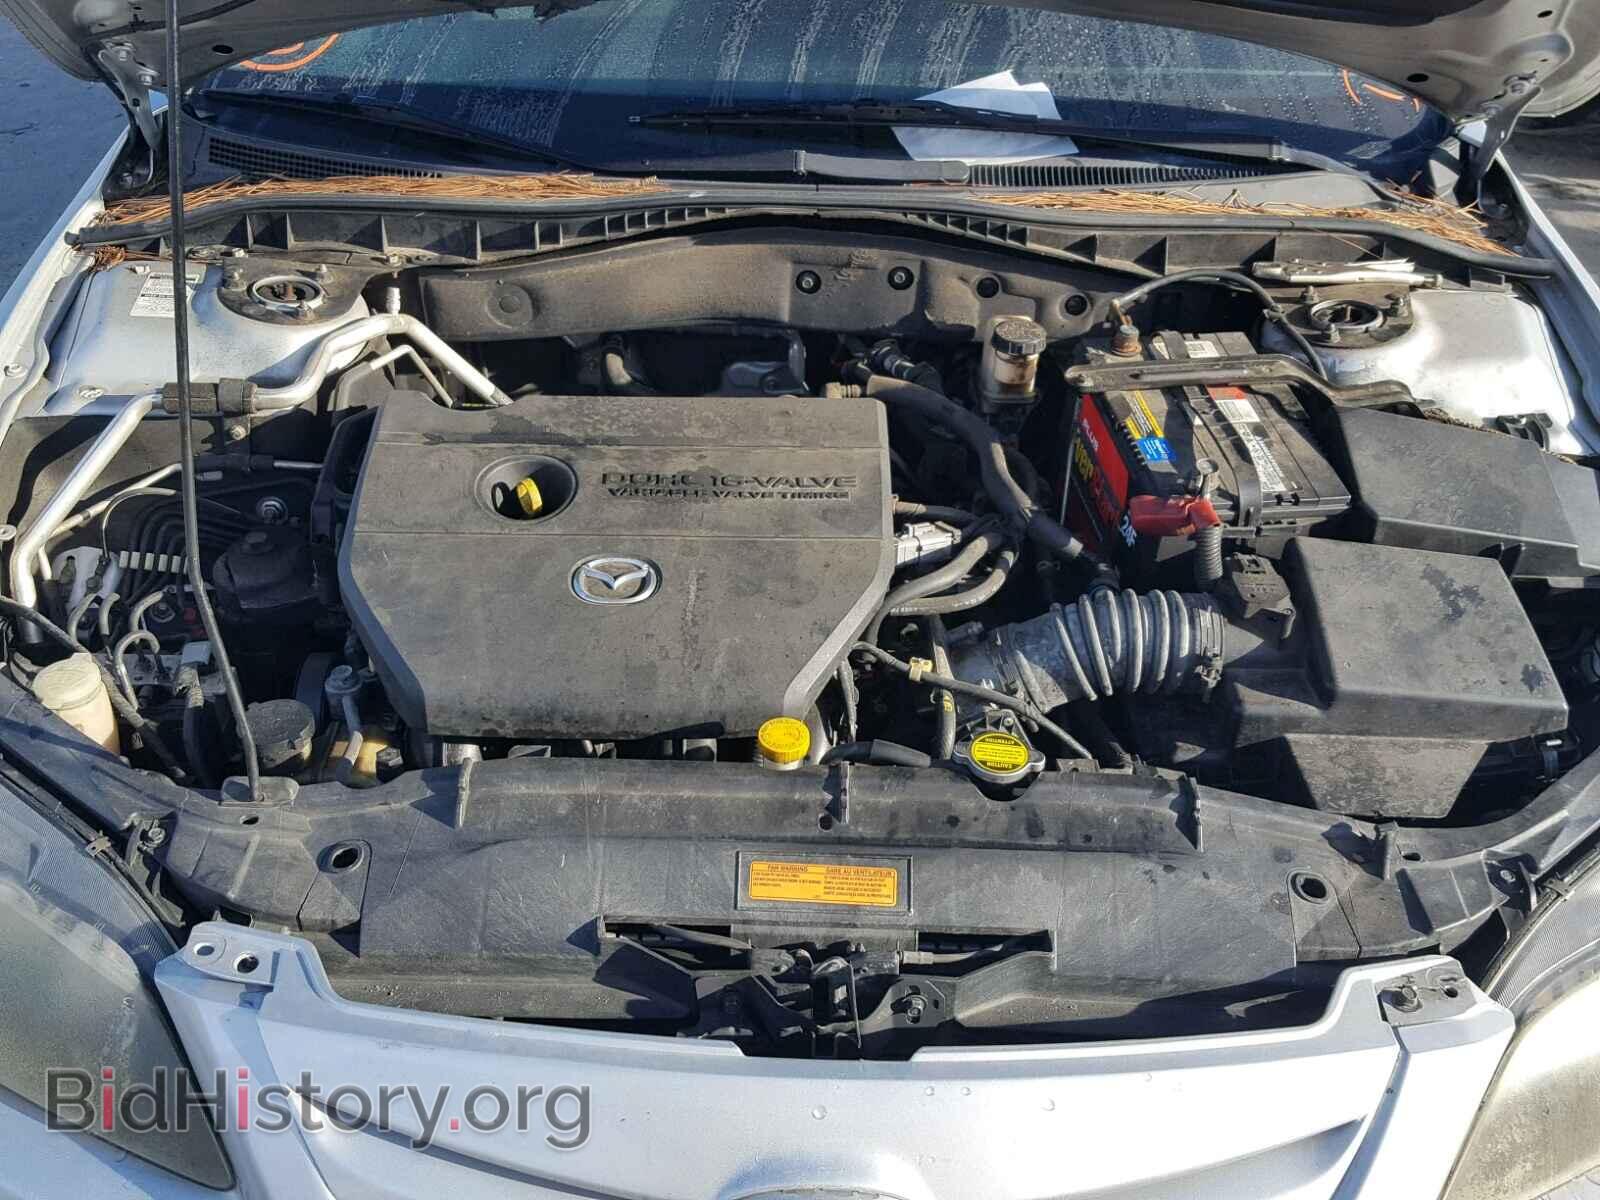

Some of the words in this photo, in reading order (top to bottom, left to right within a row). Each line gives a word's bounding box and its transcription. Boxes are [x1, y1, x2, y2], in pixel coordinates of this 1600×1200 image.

[601, 472, 704, 487] DOHC
[709, 475, 857, 488] 16-VALVE
[986, 761, 1013, 769] CAUTION
